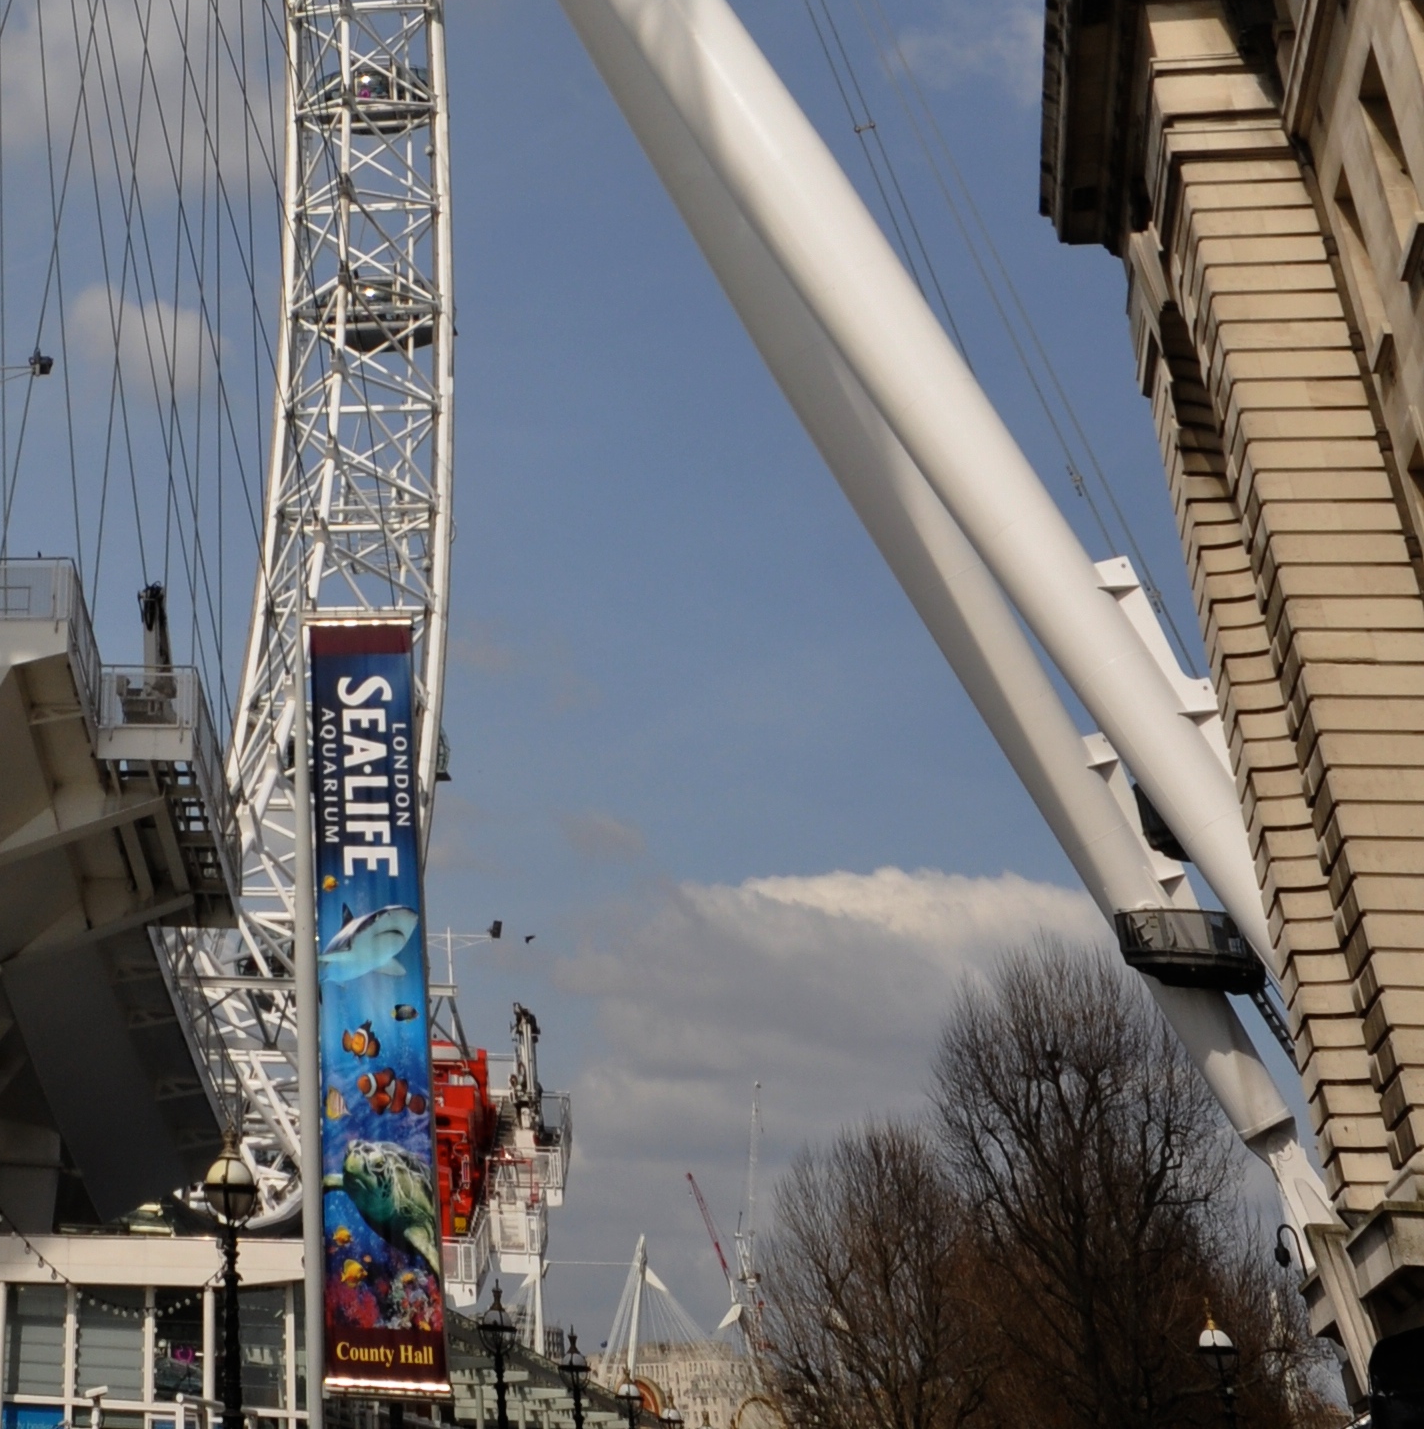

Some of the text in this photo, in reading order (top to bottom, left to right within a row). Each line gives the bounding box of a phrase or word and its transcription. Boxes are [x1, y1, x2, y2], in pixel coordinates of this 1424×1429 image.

[319, 708, 340, 843] AQUARIUM
[392, 723, 411, 827] LONDON
[336, 1341, 434, 1368] County Hall
